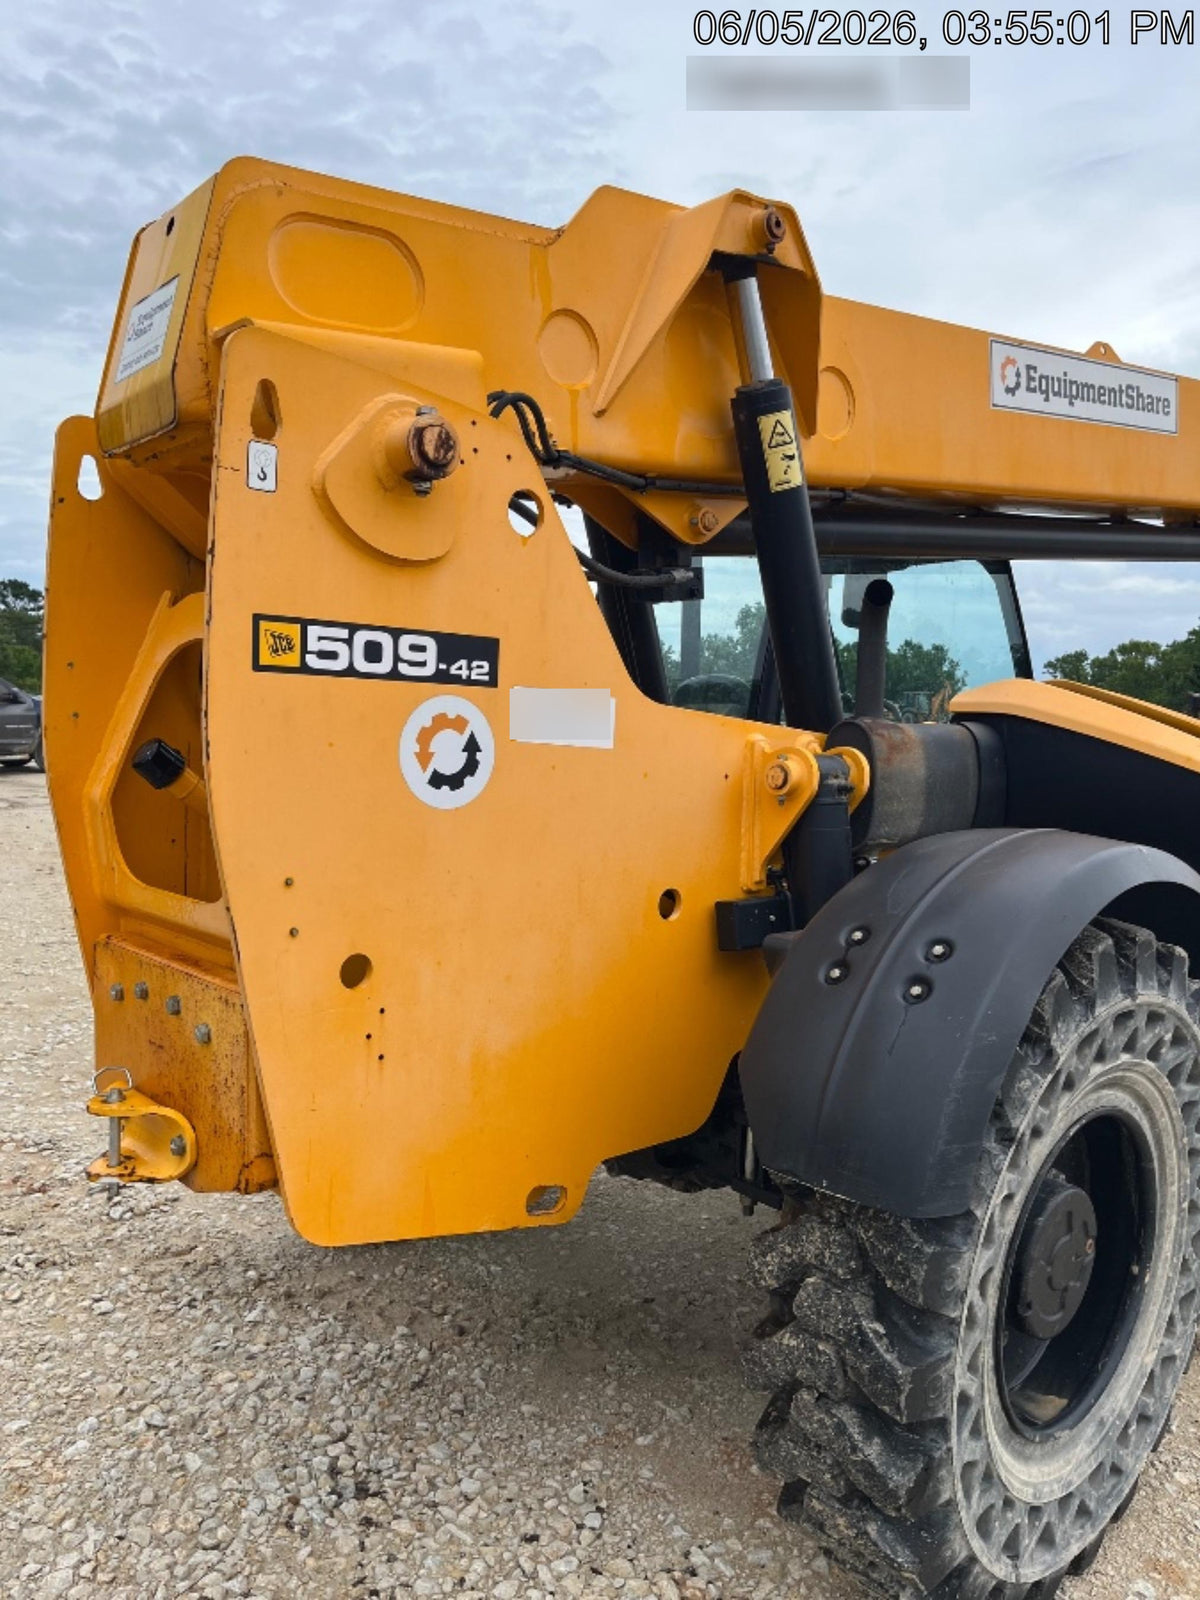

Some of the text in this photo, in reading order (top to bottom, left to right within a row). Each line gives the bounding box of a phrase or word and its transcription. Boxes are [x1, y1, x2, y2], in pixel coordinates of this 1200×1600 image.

[1025, 363, 1171, 416] EquipmentShare
[265, 630, 295, 657] JCB
[305, 625, 490, 682] 509-42
